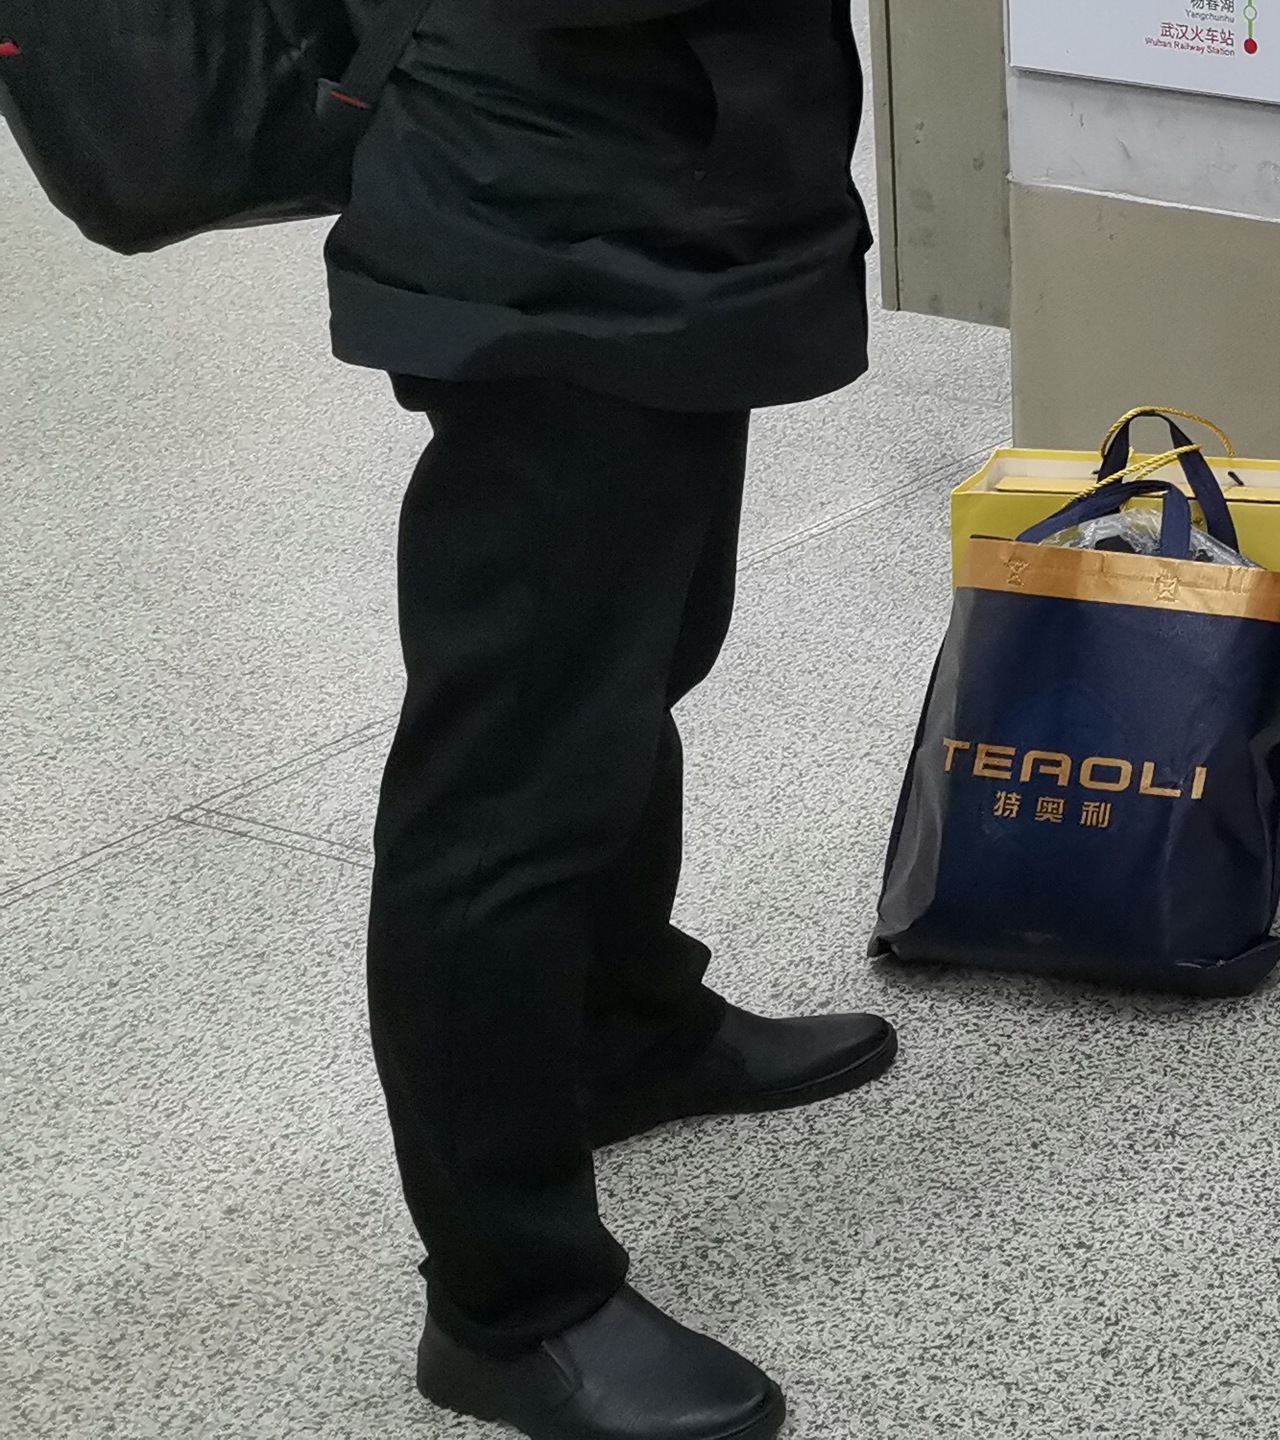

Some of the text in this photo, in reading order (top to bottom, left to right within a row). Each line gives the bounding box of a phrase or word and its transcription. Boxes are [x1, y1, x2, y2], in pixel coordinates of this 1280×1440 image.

[1160, 22, 1234, 47] 武汉火车站
[942, 738, 1208, 801] TEAOLI
[993, 790, 1111, 829] 特奥利
